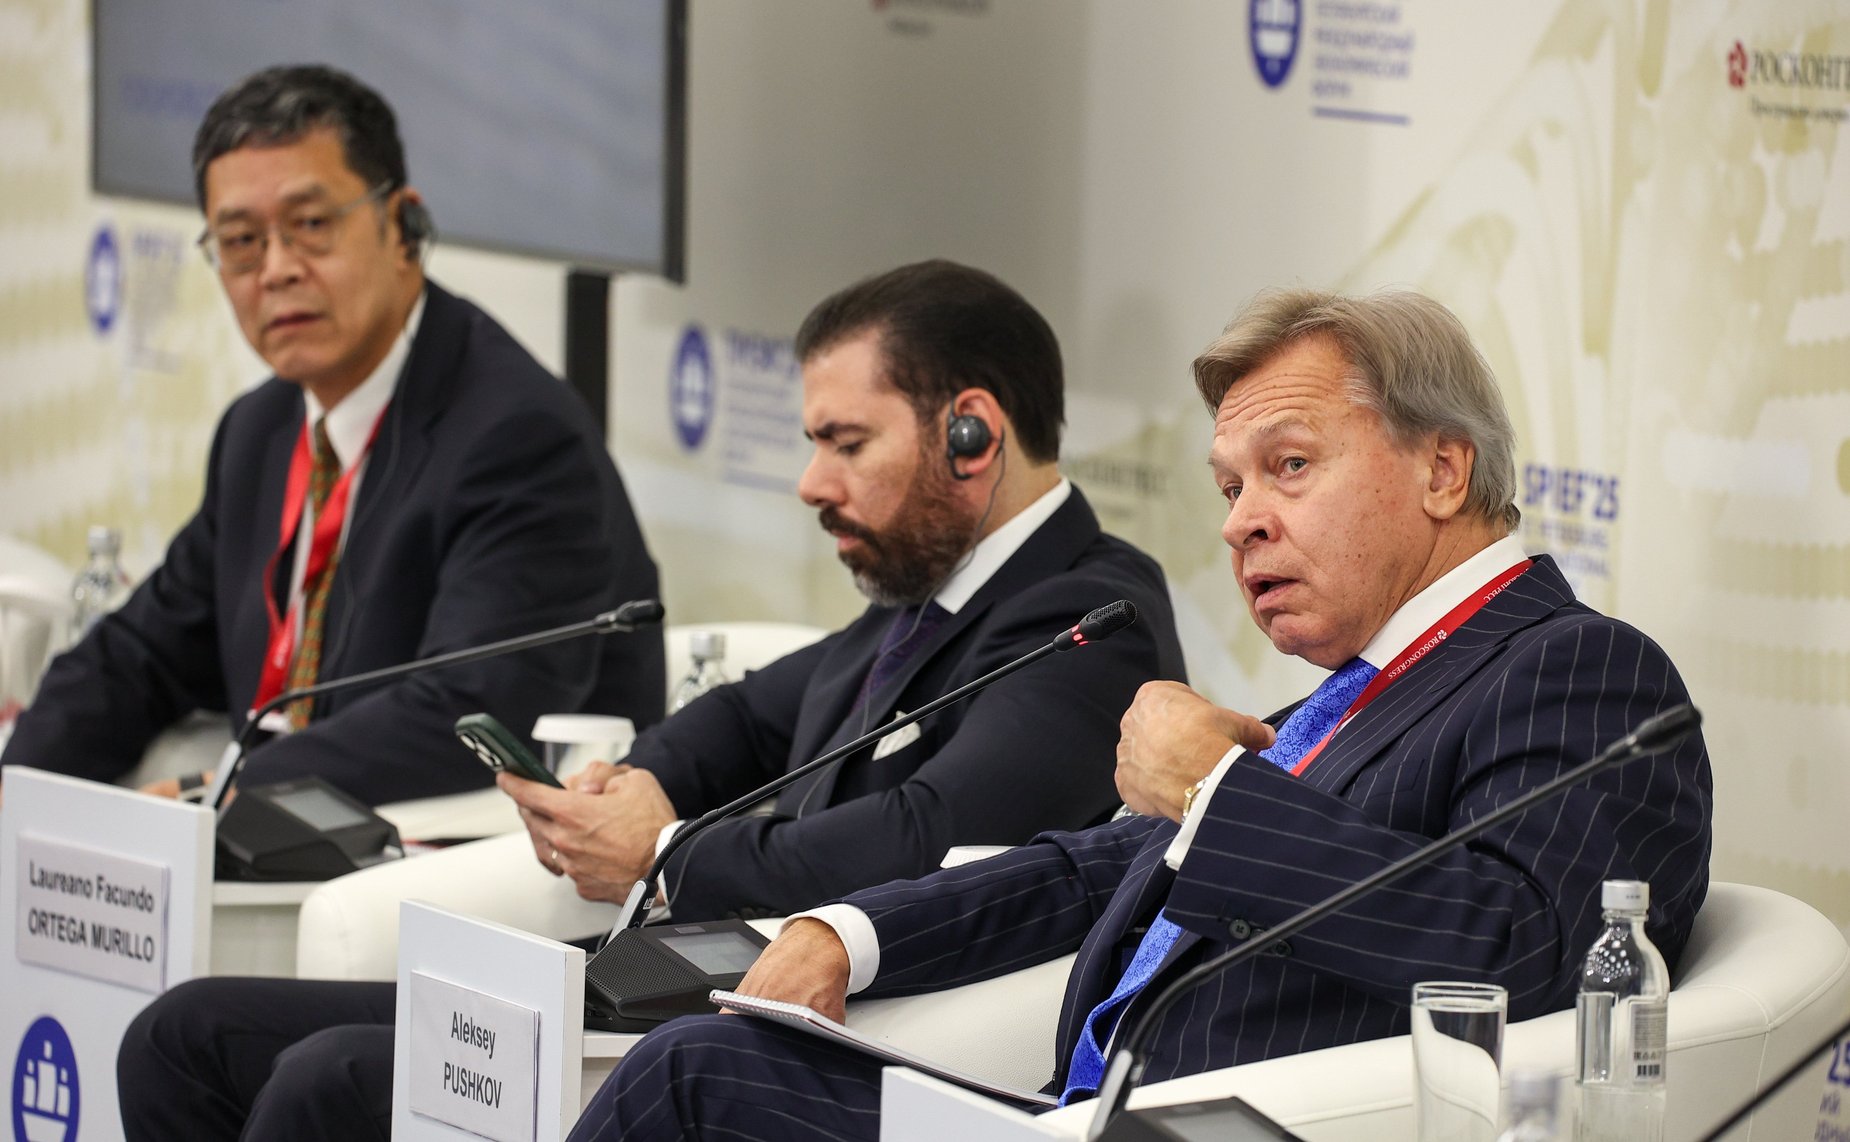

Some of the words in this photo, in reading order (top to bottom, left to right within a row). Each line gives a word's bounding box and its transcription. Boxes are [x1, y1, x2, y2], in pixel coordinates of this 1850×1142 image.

[1388, 636, 1440, 680] ROSCONGRESS
[29, 859, 93, 899] Laureano
[96, 873, 155, 914] Facundo
[28, 907, 88, 946] ORTEGA
[90, 922, 155, 962] MURILLO
[451, 1011, 496, 1060] Aleksey
[443, 1061, 502, 1109] PUSHKOV
